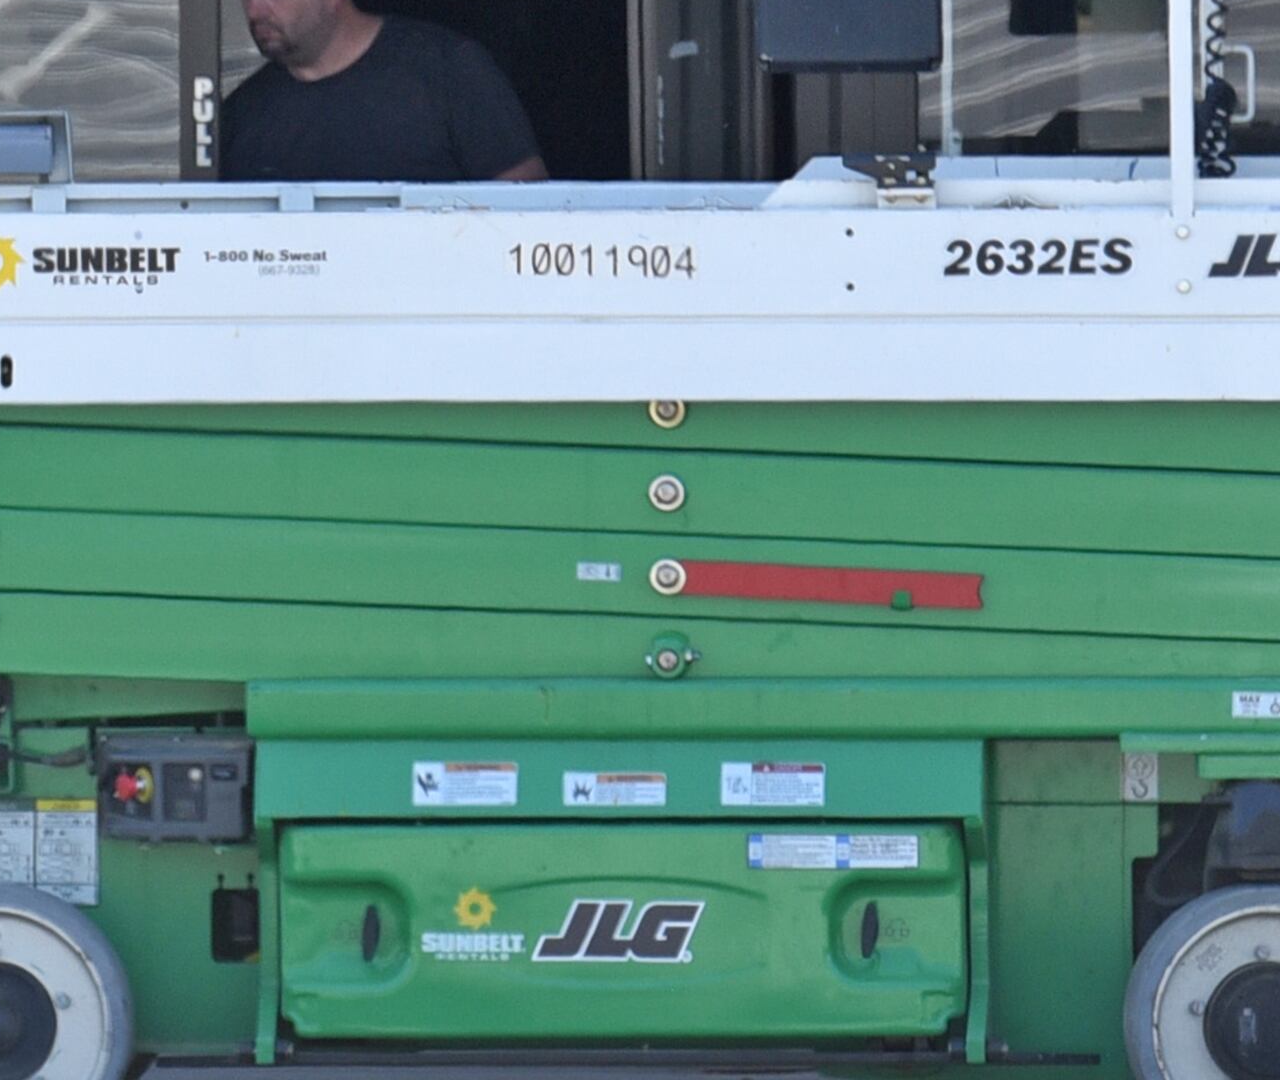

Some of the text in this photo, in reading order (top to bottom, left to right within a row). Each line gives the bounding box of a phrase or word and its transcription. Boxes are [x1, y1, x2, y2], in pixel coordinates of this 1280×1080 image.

[192, 76, 214, 168] PULL
[32, 247, 181, 273] SUNBELT
[203, 250, 328, 262] 1-800 No Sweat
[508, 242, 697, 279] 10011904
[943, 238, 1133, 276] 2632ES
[53, 274, 159, 286] RENTALS
[420, 931, 523, 953] SUNBELT
[531, 899, 705, 962] JLG
